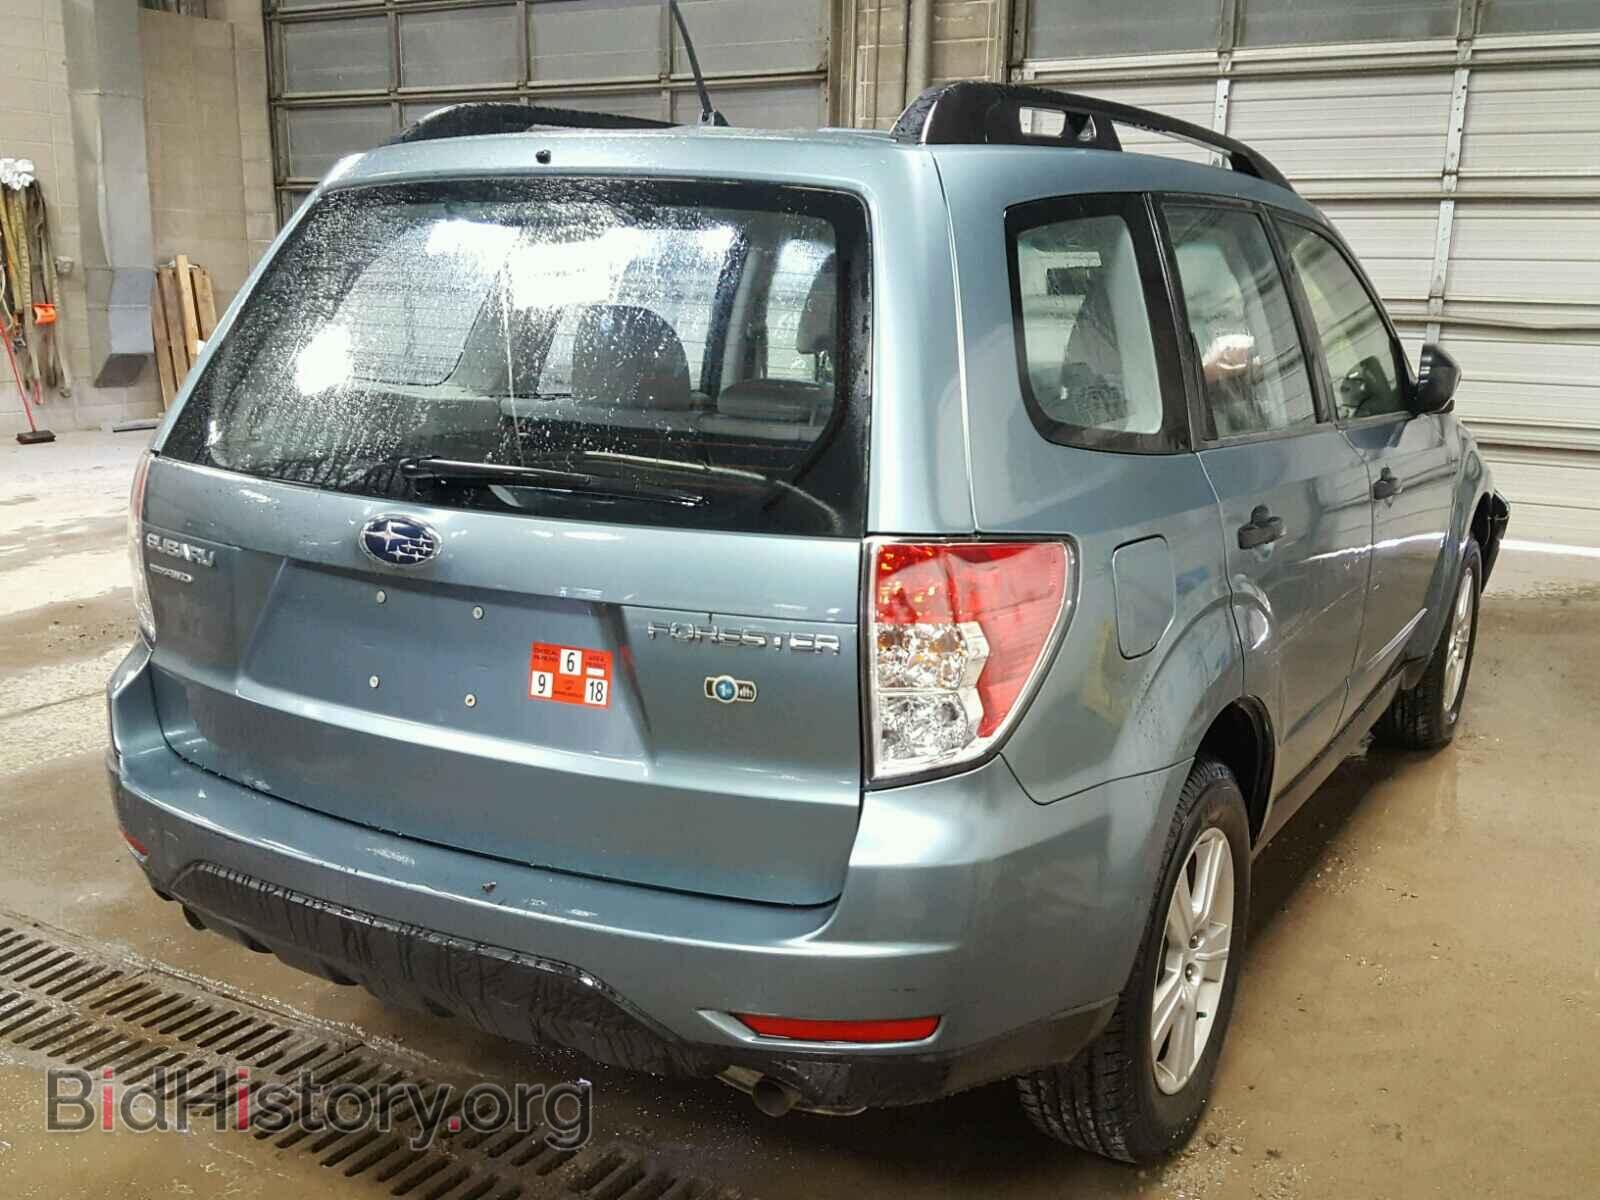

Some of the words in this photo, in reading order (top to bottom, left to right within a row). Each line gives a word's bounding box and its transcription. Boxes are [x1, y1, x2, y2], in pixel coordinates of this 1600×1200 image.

[146, 533, 215, 567] SUBARU
[648, 621, 840, 655] FORESTER
[566, 651, 576, 673] 6
[537, 673, 547, 695] 9
[589, 679, 605, 703] 18
